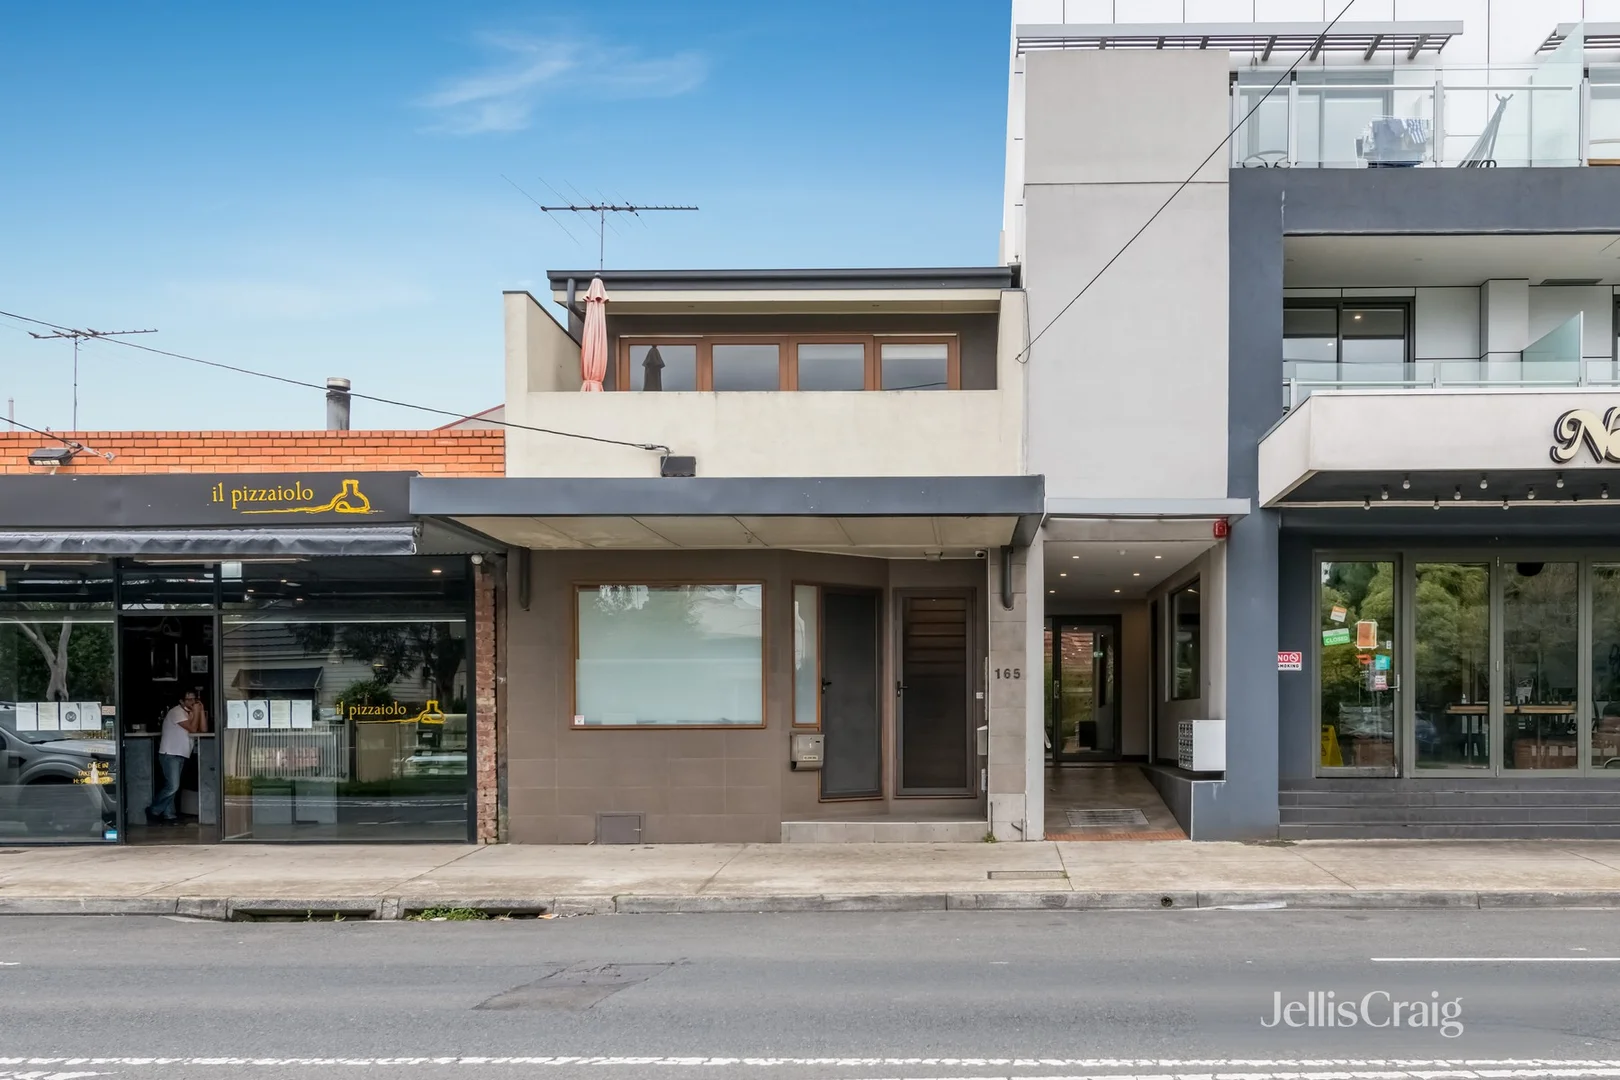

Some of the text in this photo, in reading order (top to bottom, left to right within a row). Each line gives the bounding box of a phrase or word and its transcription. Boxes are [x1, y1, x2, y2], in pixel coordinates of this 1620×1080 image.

[212, 481, 314, 510] il pizzaiolo
[1325, 635, 1348, 644] CLOSED
[994, 668, 1021, 680] 165
[336, 701, 407, 720] il pizzaiolo
